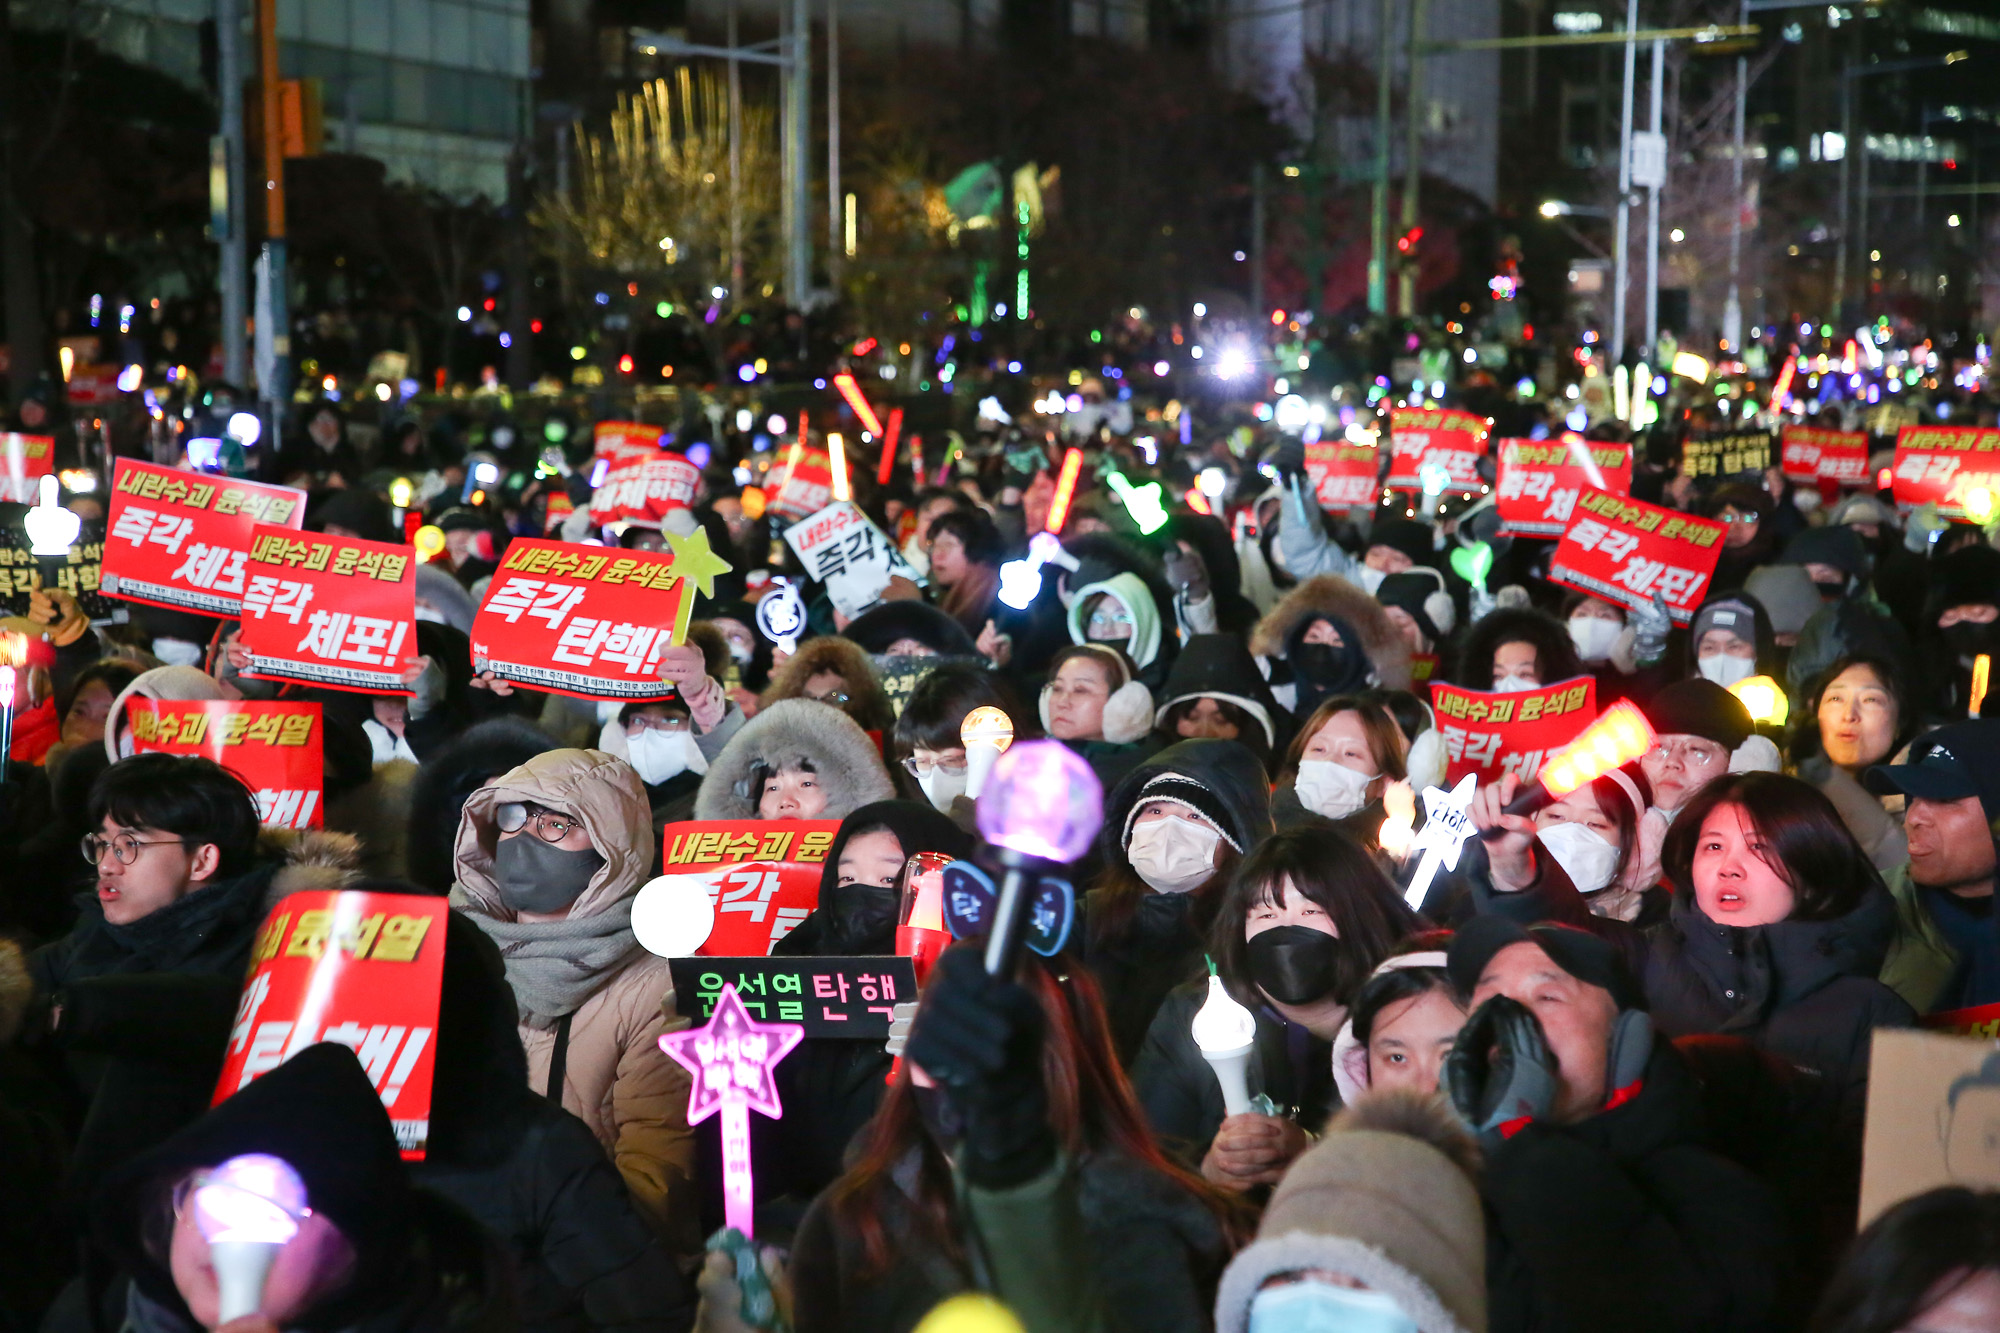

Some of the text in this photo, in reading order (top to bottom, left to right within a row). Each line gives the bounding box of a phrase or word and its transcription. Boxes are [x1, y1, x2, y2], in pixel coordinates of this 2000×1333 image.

[117, 469, 296, 524] 내란수괴 윤석열
[1578, 490, 1722, 548] 내란수괴 윤석열
[112, 505, 194, 555] 즉각
[816, 526, 875, 576] 즉각
[1567, 517, 1640, 563] 즉각
[250, 534, 408, 583] 내란수괴 윤석열
[504, 547, 609, 580] 내란수괴
[1611, 556, 1707, 606] 체포!
[242, 575, 314, 624] 즉각
[484, 577, 586, 630] 즉각
[296, 609, 409, 668] 체포!
[551, 616, 671, 675] 탄핵!
[1436, 683, 1588, 724] 내란수괴 윤석열
[211, 713, 314, 746] 윤석열
[1442, 724, 1503, 768] 즉각
[668, 831, 795, 865] 내란수괴
[697, 972, 897, 1023] 윤석열 탄핵
